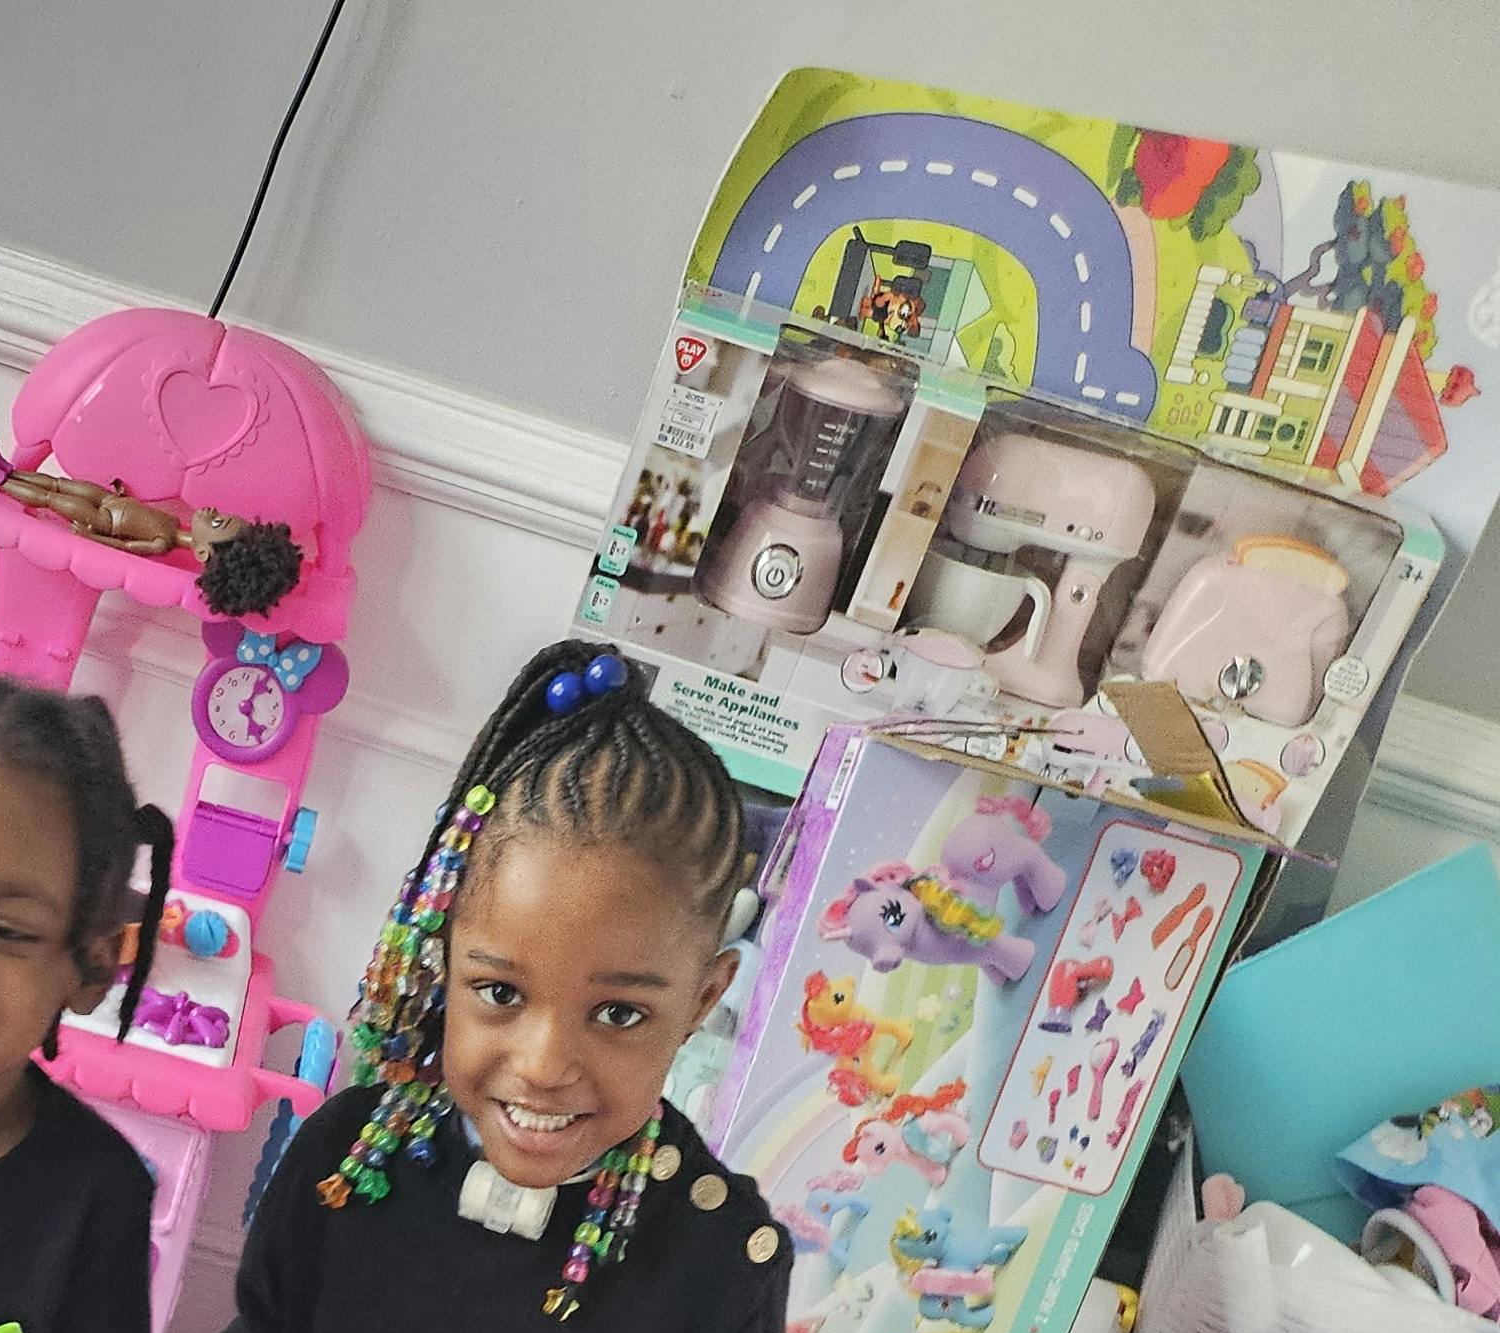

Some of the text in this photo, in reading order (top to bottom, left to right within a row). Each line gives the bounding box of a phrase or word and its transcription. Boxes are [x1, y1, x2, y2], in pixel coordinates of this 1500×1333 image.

[677, 340, 704, 356] PLAY
[1399, 563, 1423, 583] 3+
[215, 687, 225, 698] 9
[704, 675, 781, 708] Make and
[673, 680, 714, 705] Serve
[717, 697, 800, 731] Appliances
